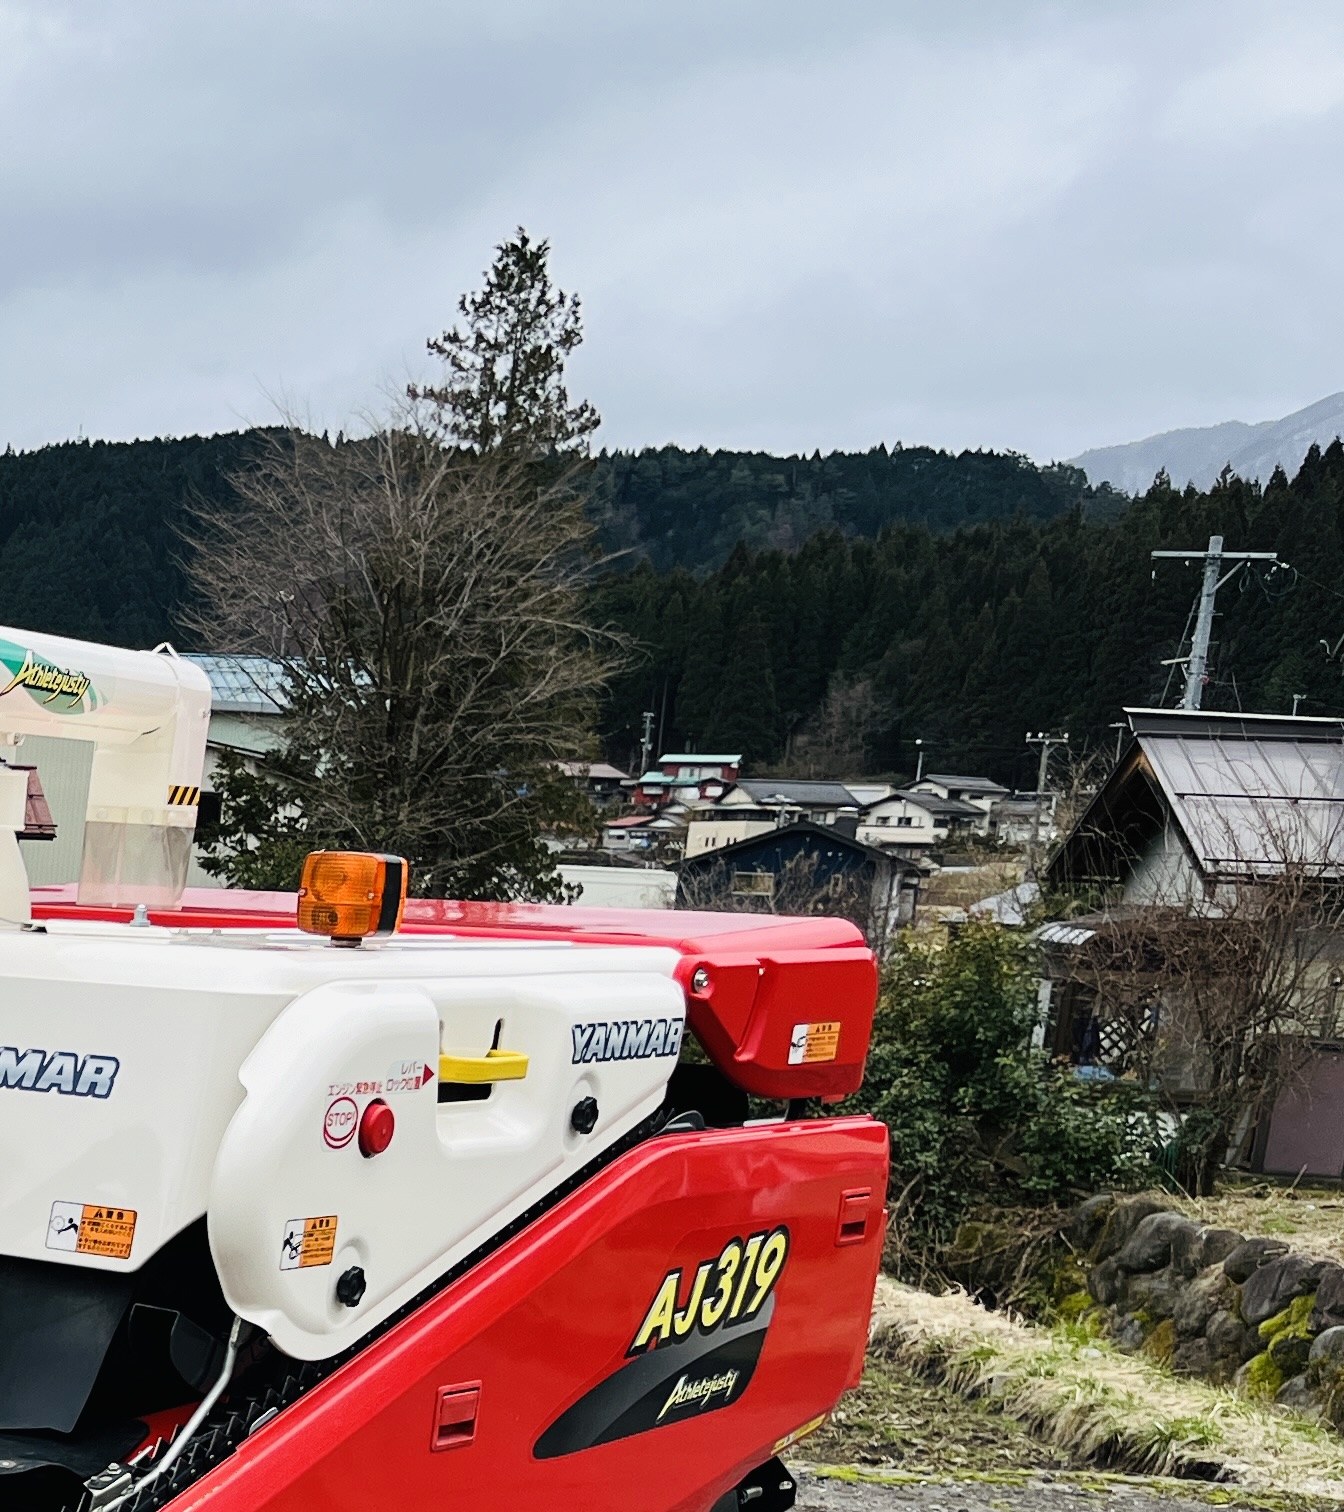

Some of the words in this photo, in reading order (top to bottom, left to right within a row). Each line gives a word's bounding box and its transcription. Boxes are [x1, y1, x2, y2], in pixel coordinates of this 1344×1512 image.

[571, 1018, 684, 1065] YANMAR
[401, 1061, 422, 1075] レバー
[624, 1225, 790, 1358] AJ319
